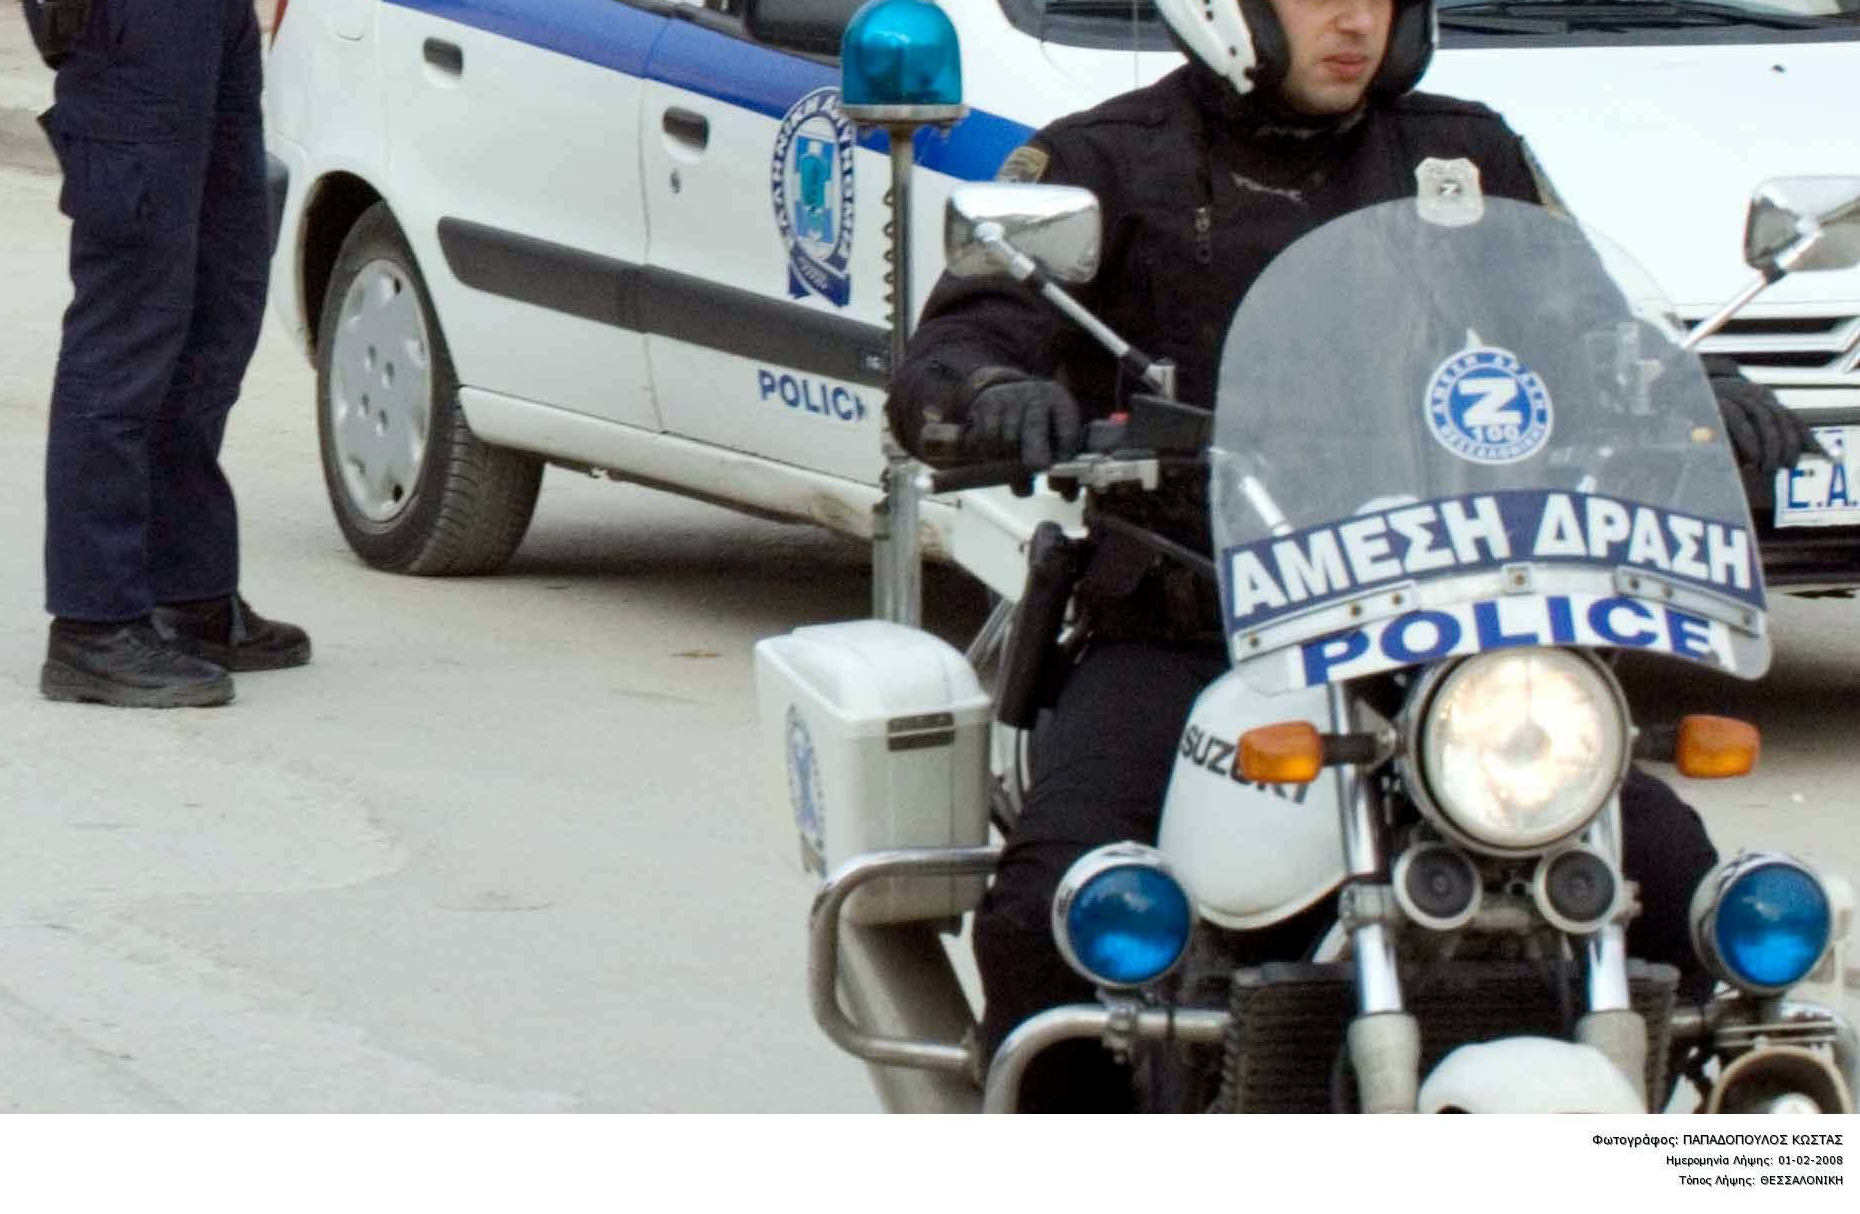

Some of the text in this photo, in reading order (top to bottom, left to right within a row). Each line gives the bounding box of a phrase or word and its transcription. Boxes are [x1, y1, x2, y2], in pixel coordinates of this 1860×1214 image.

[1230, 493, 1752, 618] ΑΜΕΣΗ ΔΡΑΣΗ
[1300, 596, 1714, 688] POLICE
[1181, 724, 1309, 804] SUZ
